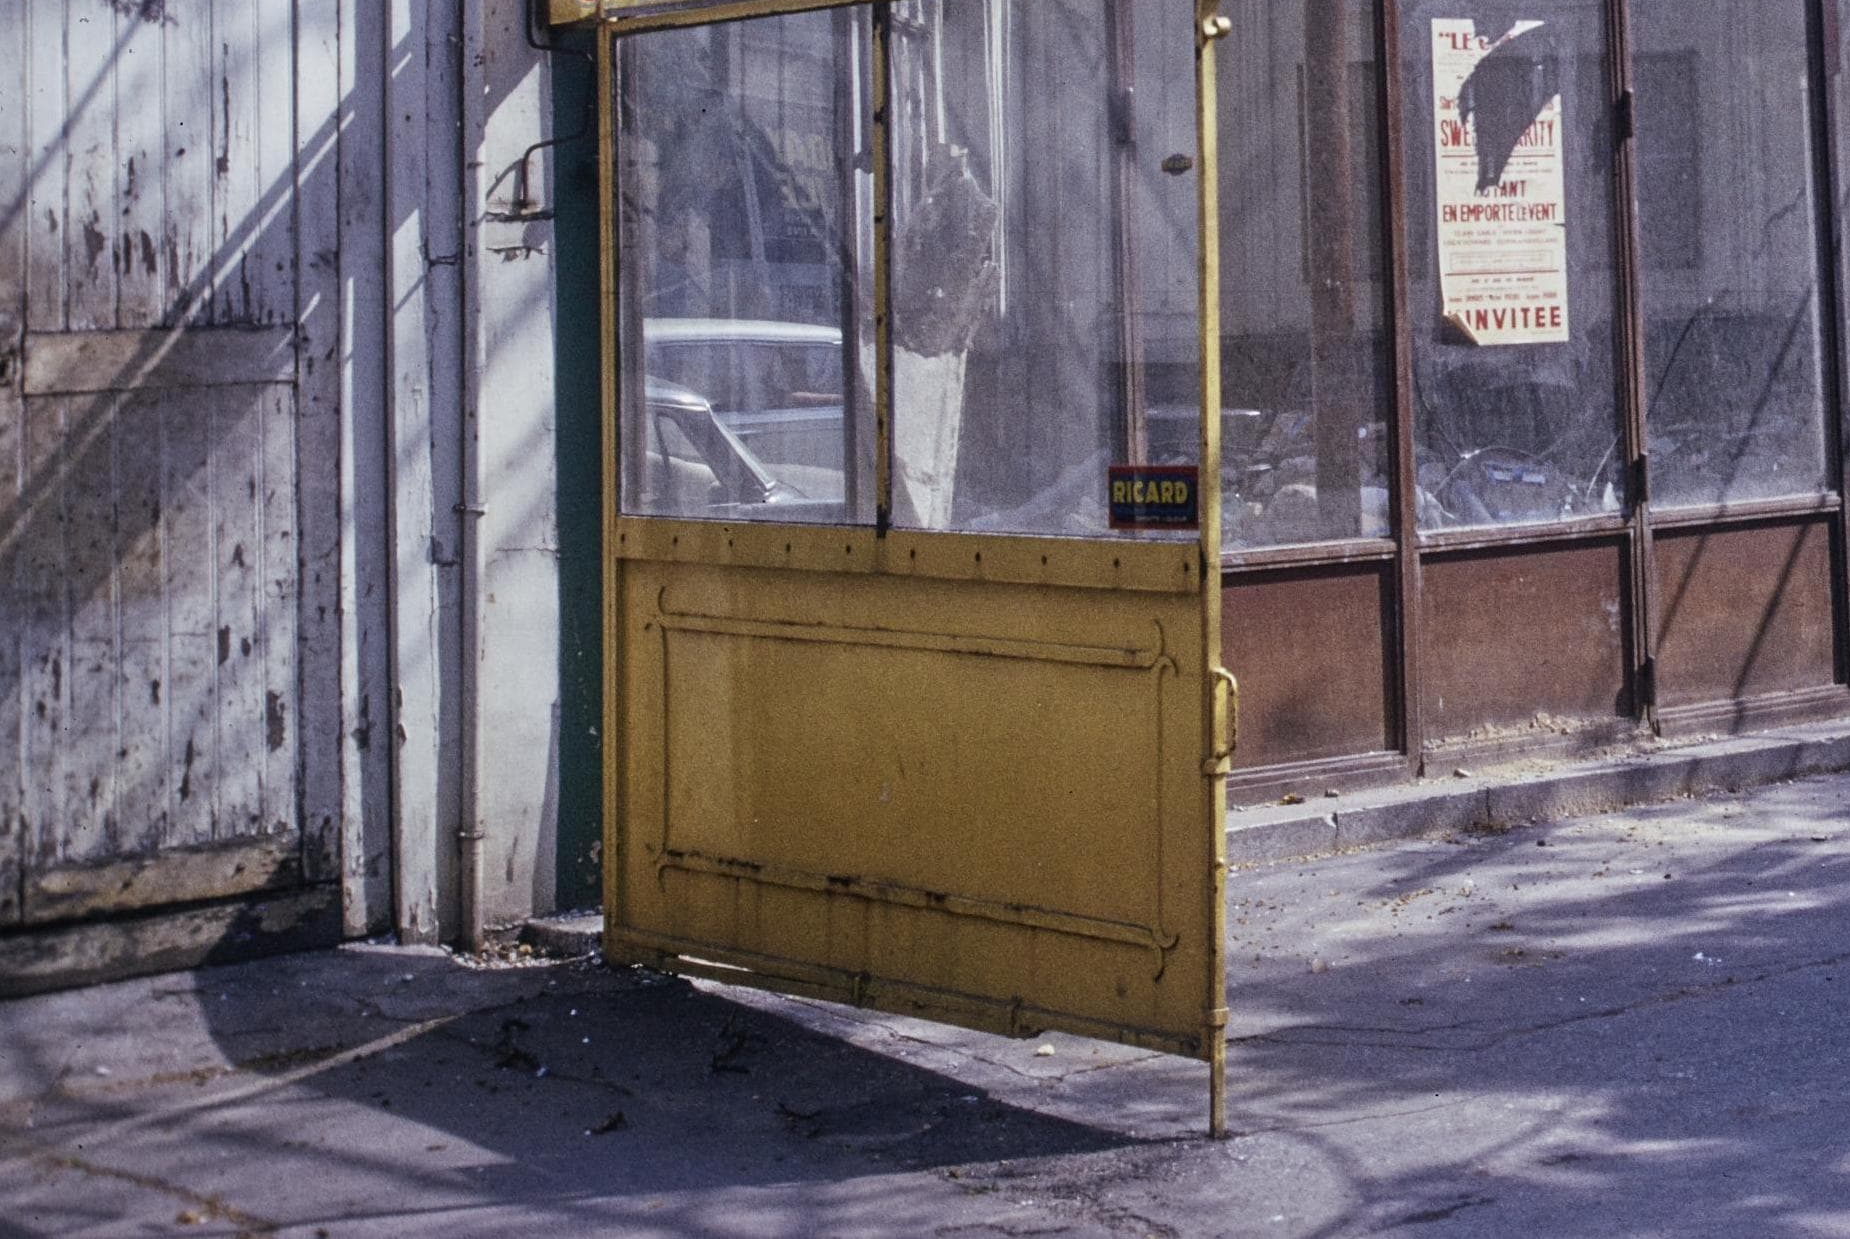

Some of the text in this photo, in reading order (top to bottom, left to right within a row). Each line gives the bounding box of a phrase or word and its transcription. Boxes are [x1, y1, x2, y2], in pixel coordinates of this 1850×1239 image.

[1441, 120, 1475, 147] SWE
[1442, 204, 1457, 222] EN
[1460, 204, 1514, 222] EMPORTE
[1528, 203, 1557, 221] VENT
[1464, 306, 1561, 331] INVITEE
[1113, 480, 1188, 504] RICARD
